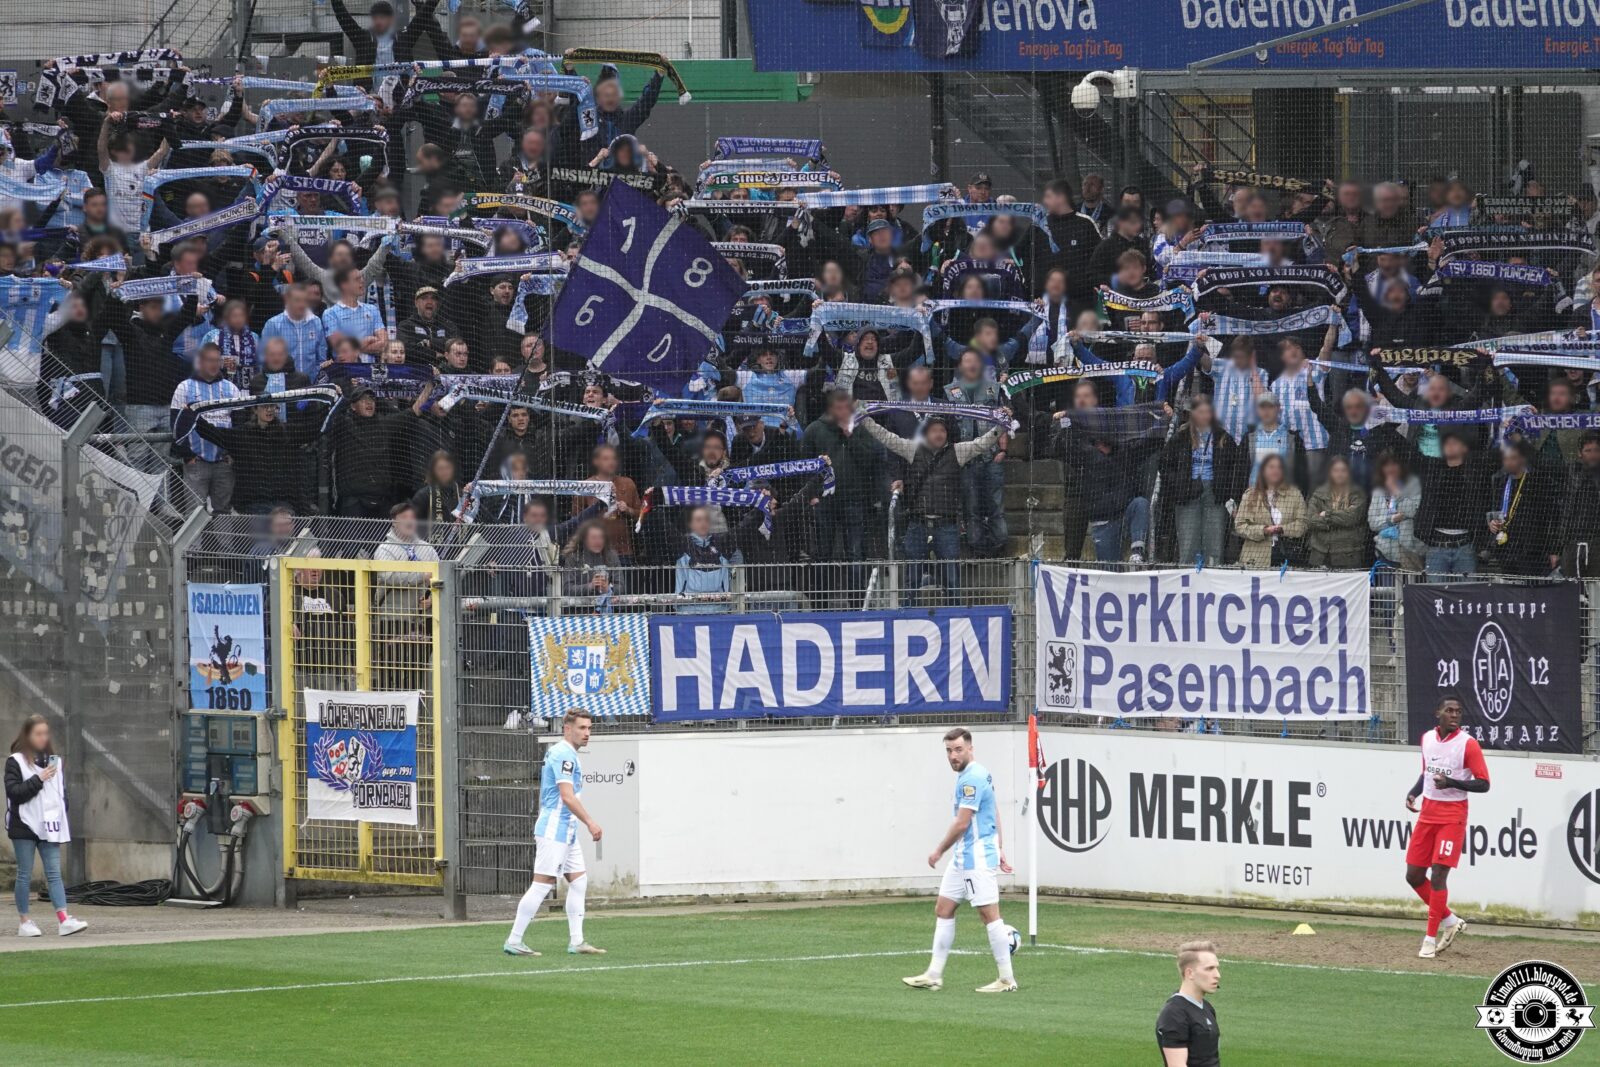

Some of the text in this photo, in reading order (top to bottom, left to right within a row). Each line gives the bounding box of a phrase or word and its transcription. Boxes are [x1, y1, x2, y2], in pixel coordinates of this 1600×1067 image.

[1019, 39, 1124, 61] Energie. Tag für Tag
[1323, 37, 1344, 58] Tag
[1365, 37, 1385, 58] Tag
[1545, 38, 1592, 59] Energie.
[684, 257, 713, 288] 8
[1449, 262, 1466, 276] TSV
[1470, 263, 1496, 277] 1860
[763, 280, 816, 291] MÜNCHE
[575, 295, 604, 327] 6
[1562, 343, 1600, 351] MÜNC
[1007, 371, 1033, 388] WIR
[1034, 366, 1067, 379] SIND
[1084, 362, 1110, 372] DER
[1480, 408, 1499, 419] TSV
[1523, 415, 1600, 429] MÜNCHEN 18
[0, 435, 58, 495] GER
[672, 488, 756, 505] 1860
[1041, 569, 1349, 646] Vierkirchen
[1434, 598, 1547, 620] Reisegruppe
[658, 616, 1003, 712] HADERN
[1437, 658, 1460, 687] 20
[1528, 656, 1550, 685] 12
[1083, 645, 1367, 715] Pasenbach
[206, 687, 252, 711] 1860
[1051, 693, 1070, 705] 1860
[1481, 687, 1508, 714] 1860
[318, 699, 407, 731] LÖWENFANCLUB
[398, 766, 413, 776] 1991
[582, 771, 624, 785] reiburg
[1426, 767, 1453, 777] OBRAD
[352, 779, 413, 811] PÖRNBACH
[1439, 839, 1454, 856] 19
[1243, 862, 1313, 887] BEWEGT
